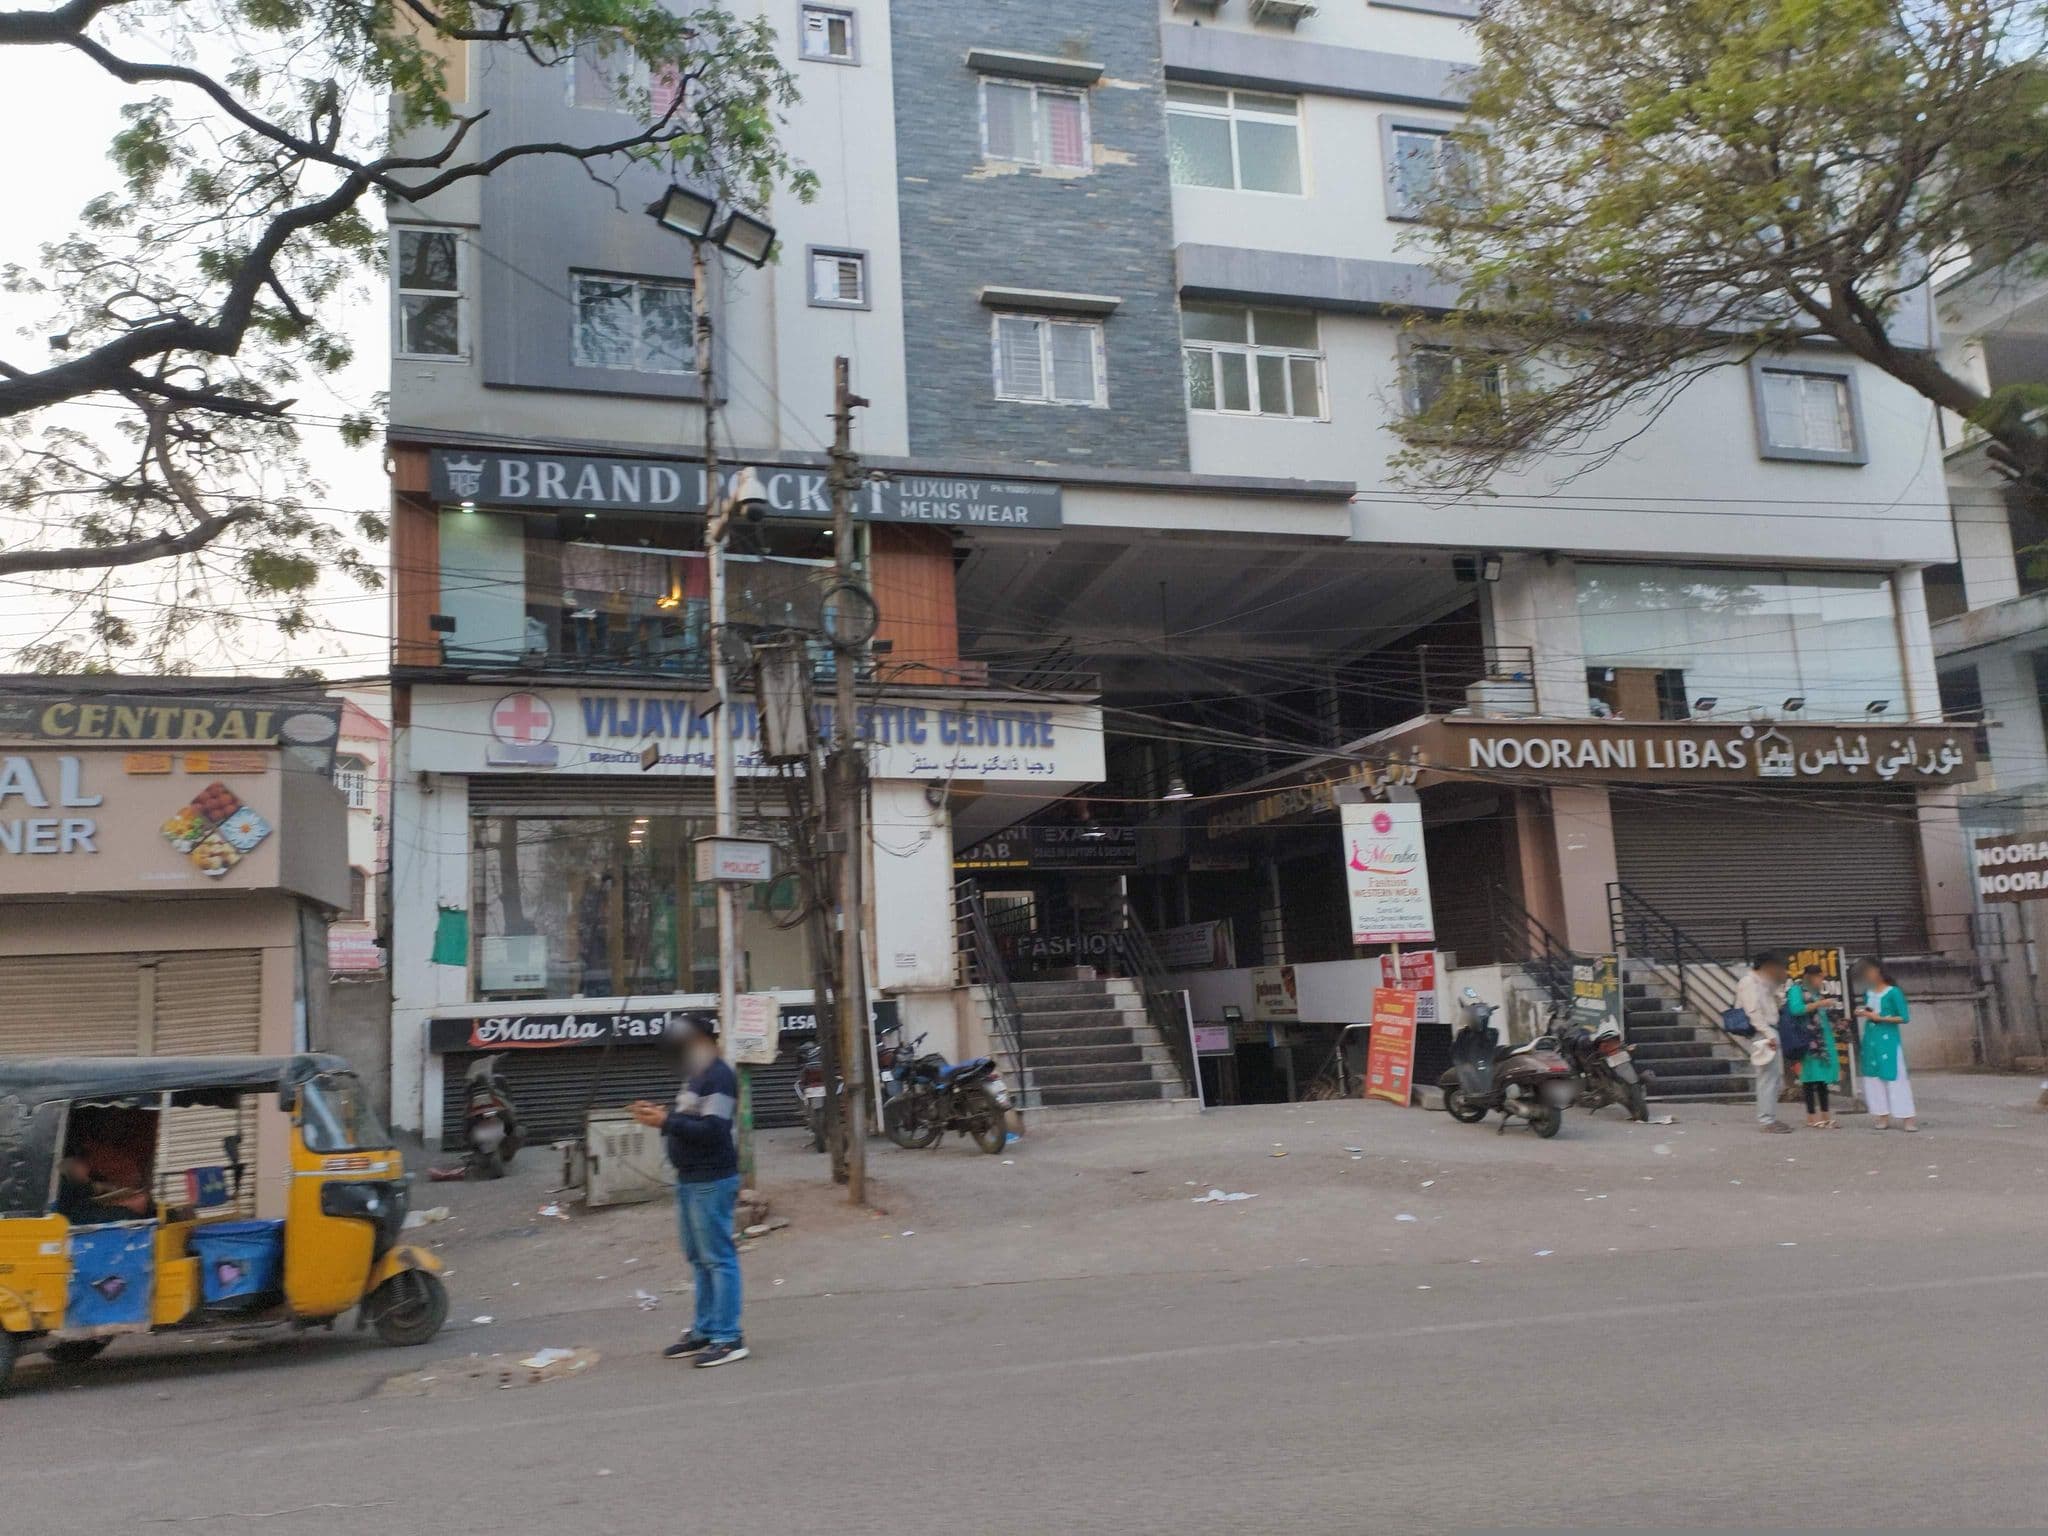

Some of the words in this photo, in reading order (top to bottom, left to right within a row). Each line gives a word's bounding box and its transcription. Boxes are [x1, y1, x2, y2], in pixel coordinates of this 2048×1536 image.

[498, 459, 681, 504] BRAND
[697, 469, 891, 515] PCKT
[900, 479, 981, 500] LUXURY
[900, 501, 962, 520] MENS
[967, 503, 1029, 523] WEAR
[41, 702, 279, 742] CENTRAL
[939, 710, 1055, 747] CENTRE
[1468, 738, 1637, 769] NOORANI
[1645, 739, 1747, 769] LIBAS
[1017, 935, 1125, 955] FASHION
[478, 1015, 605, 1041] Manha
